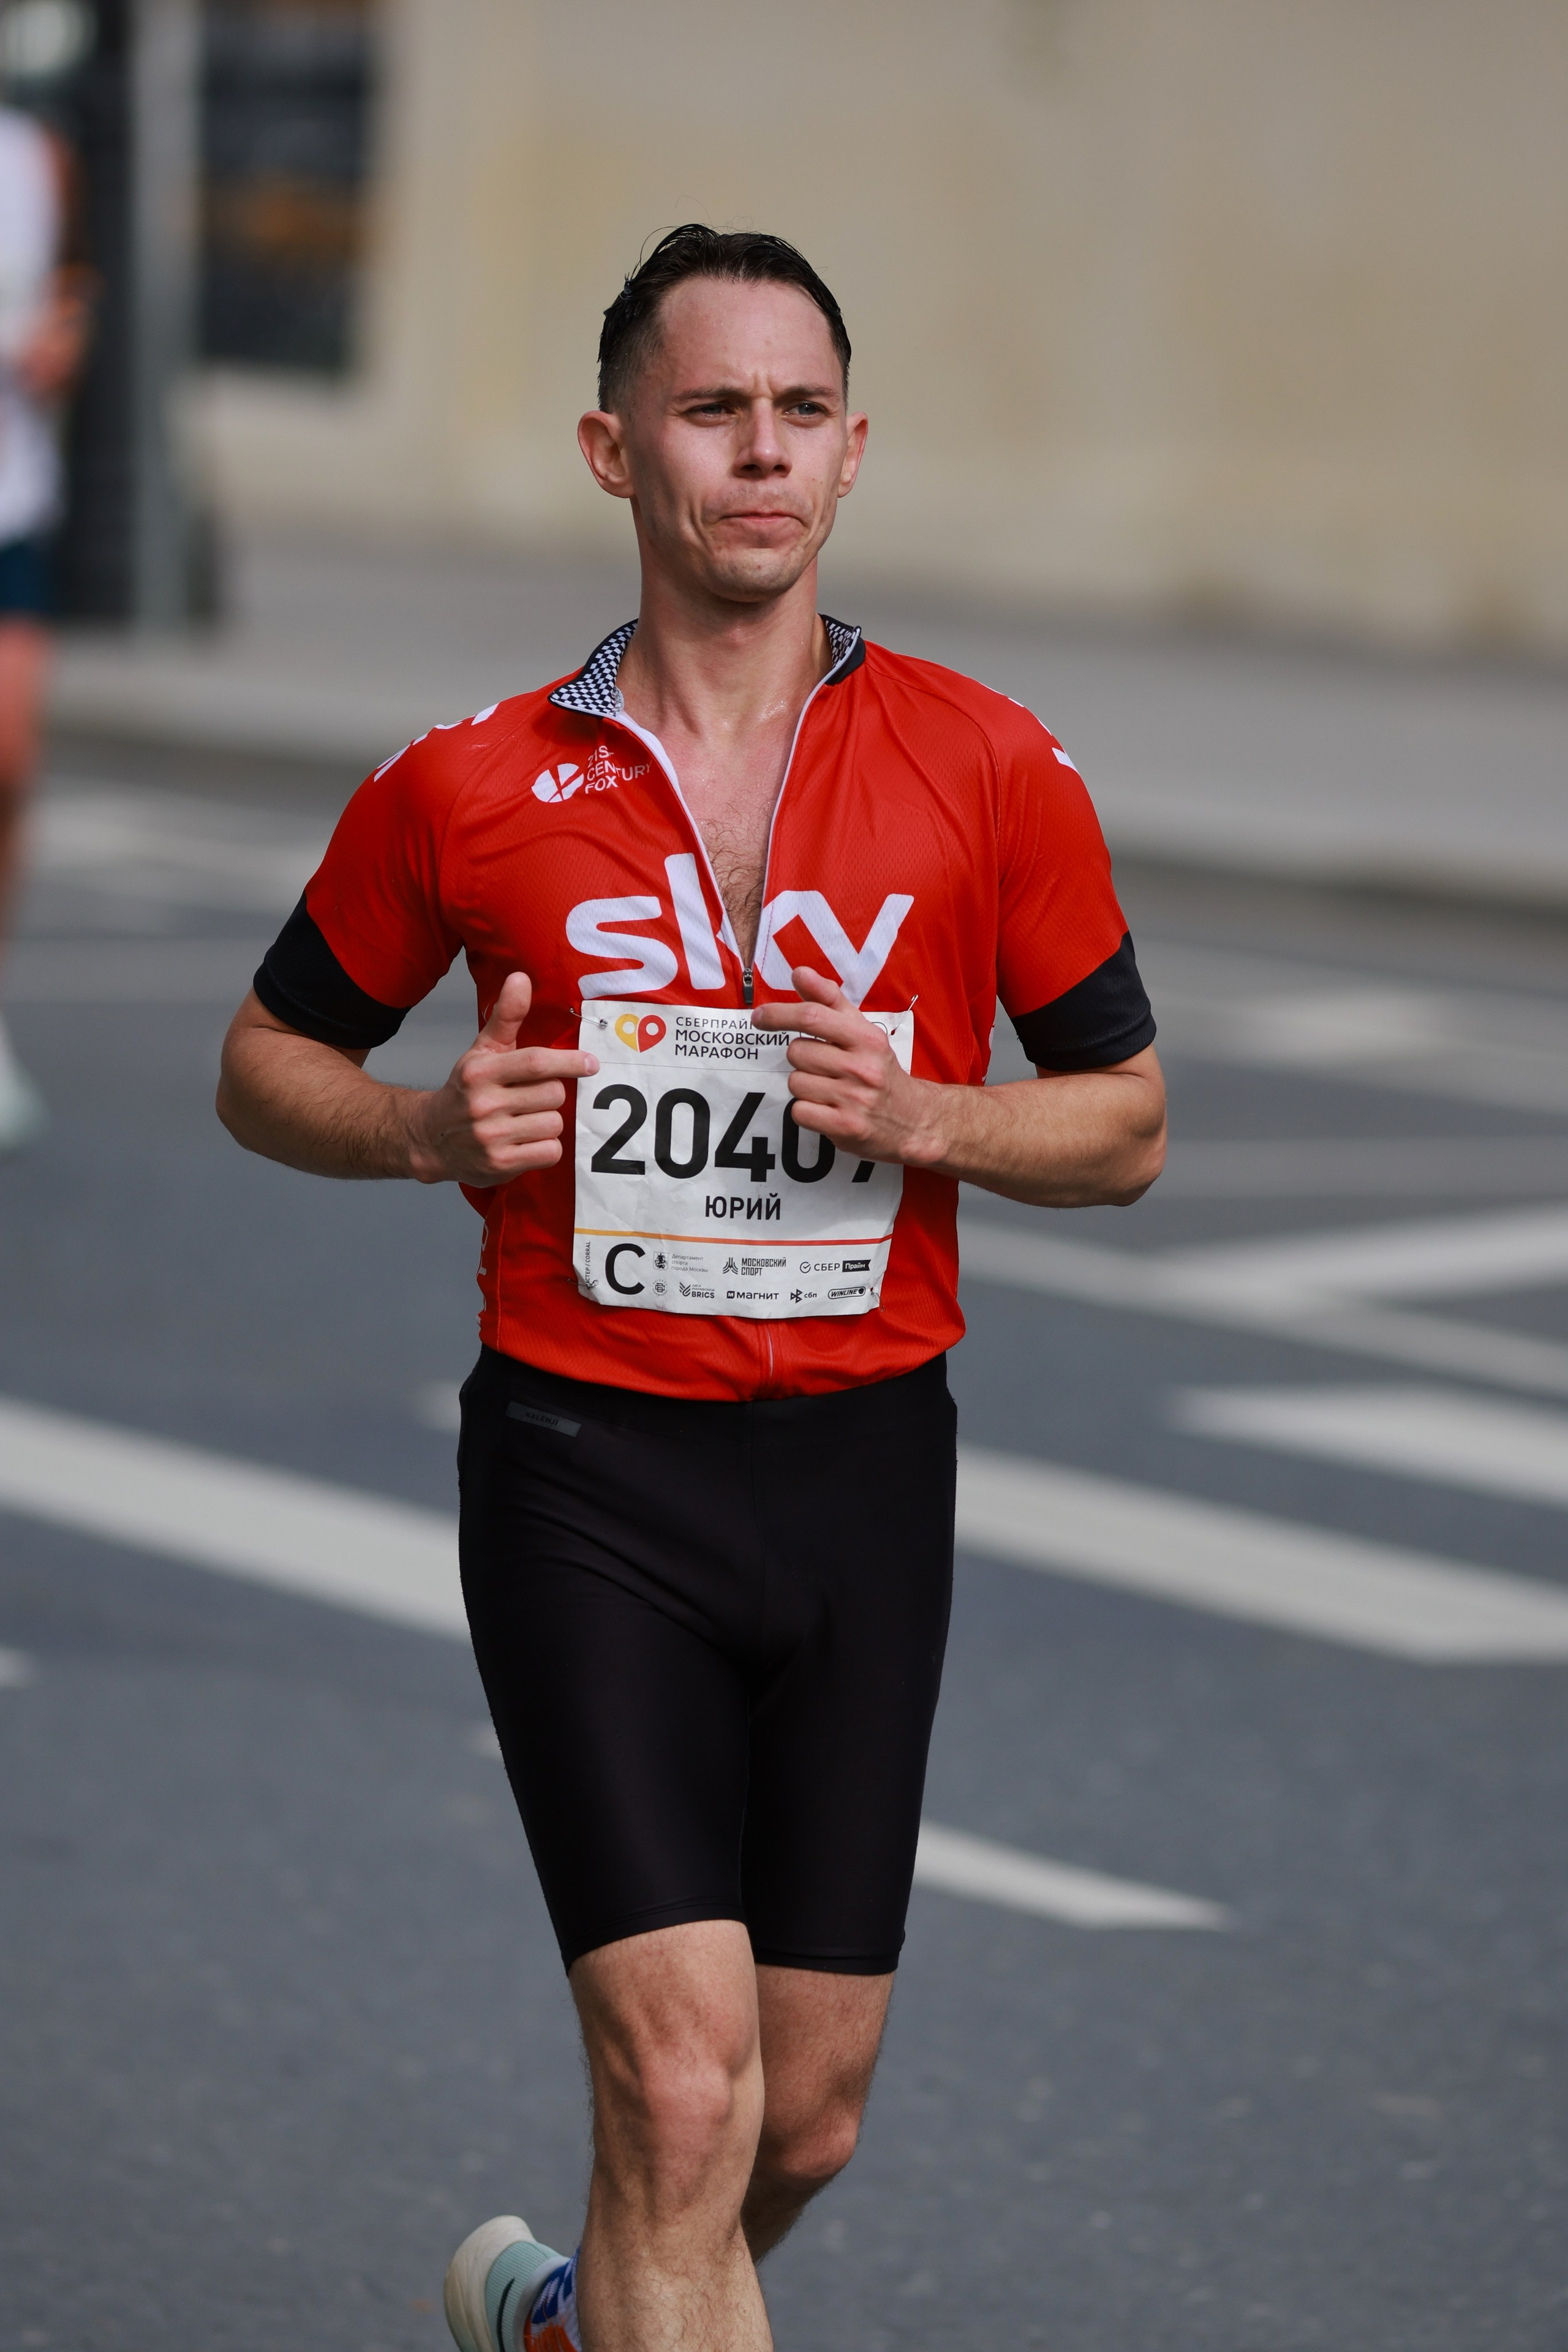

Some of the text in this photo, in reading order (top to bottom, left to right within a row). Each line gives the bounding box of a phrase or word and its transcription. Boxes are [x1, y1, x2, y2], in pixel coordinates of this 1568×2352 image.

[587, 760, 652, 781] CENTURY
[585, 775, 619, 794] FOX
[565, 852, 914, 1009] sky
[676, 1016, 753, 1030] СБЕРПРАЙ
[675, 1029, 790, 1046] МОСКОВСКИЙ
[674, 1044, 759, 1060] МАРАФОН
[590, 1084, 876, 1184] 2040
[704, 1193, 782, 1220] ЮРИЙ
[741, 1257, 786, 1268] МОСКОВСКИЙ
[814, 1262, 866, 1272] СБЕР Прайм
[741, 1267, 763, 1276] СПОРТ
[831, 1289, 858, 1298] WINLINE
[524, 1411, 560, 1426] KALENJI
